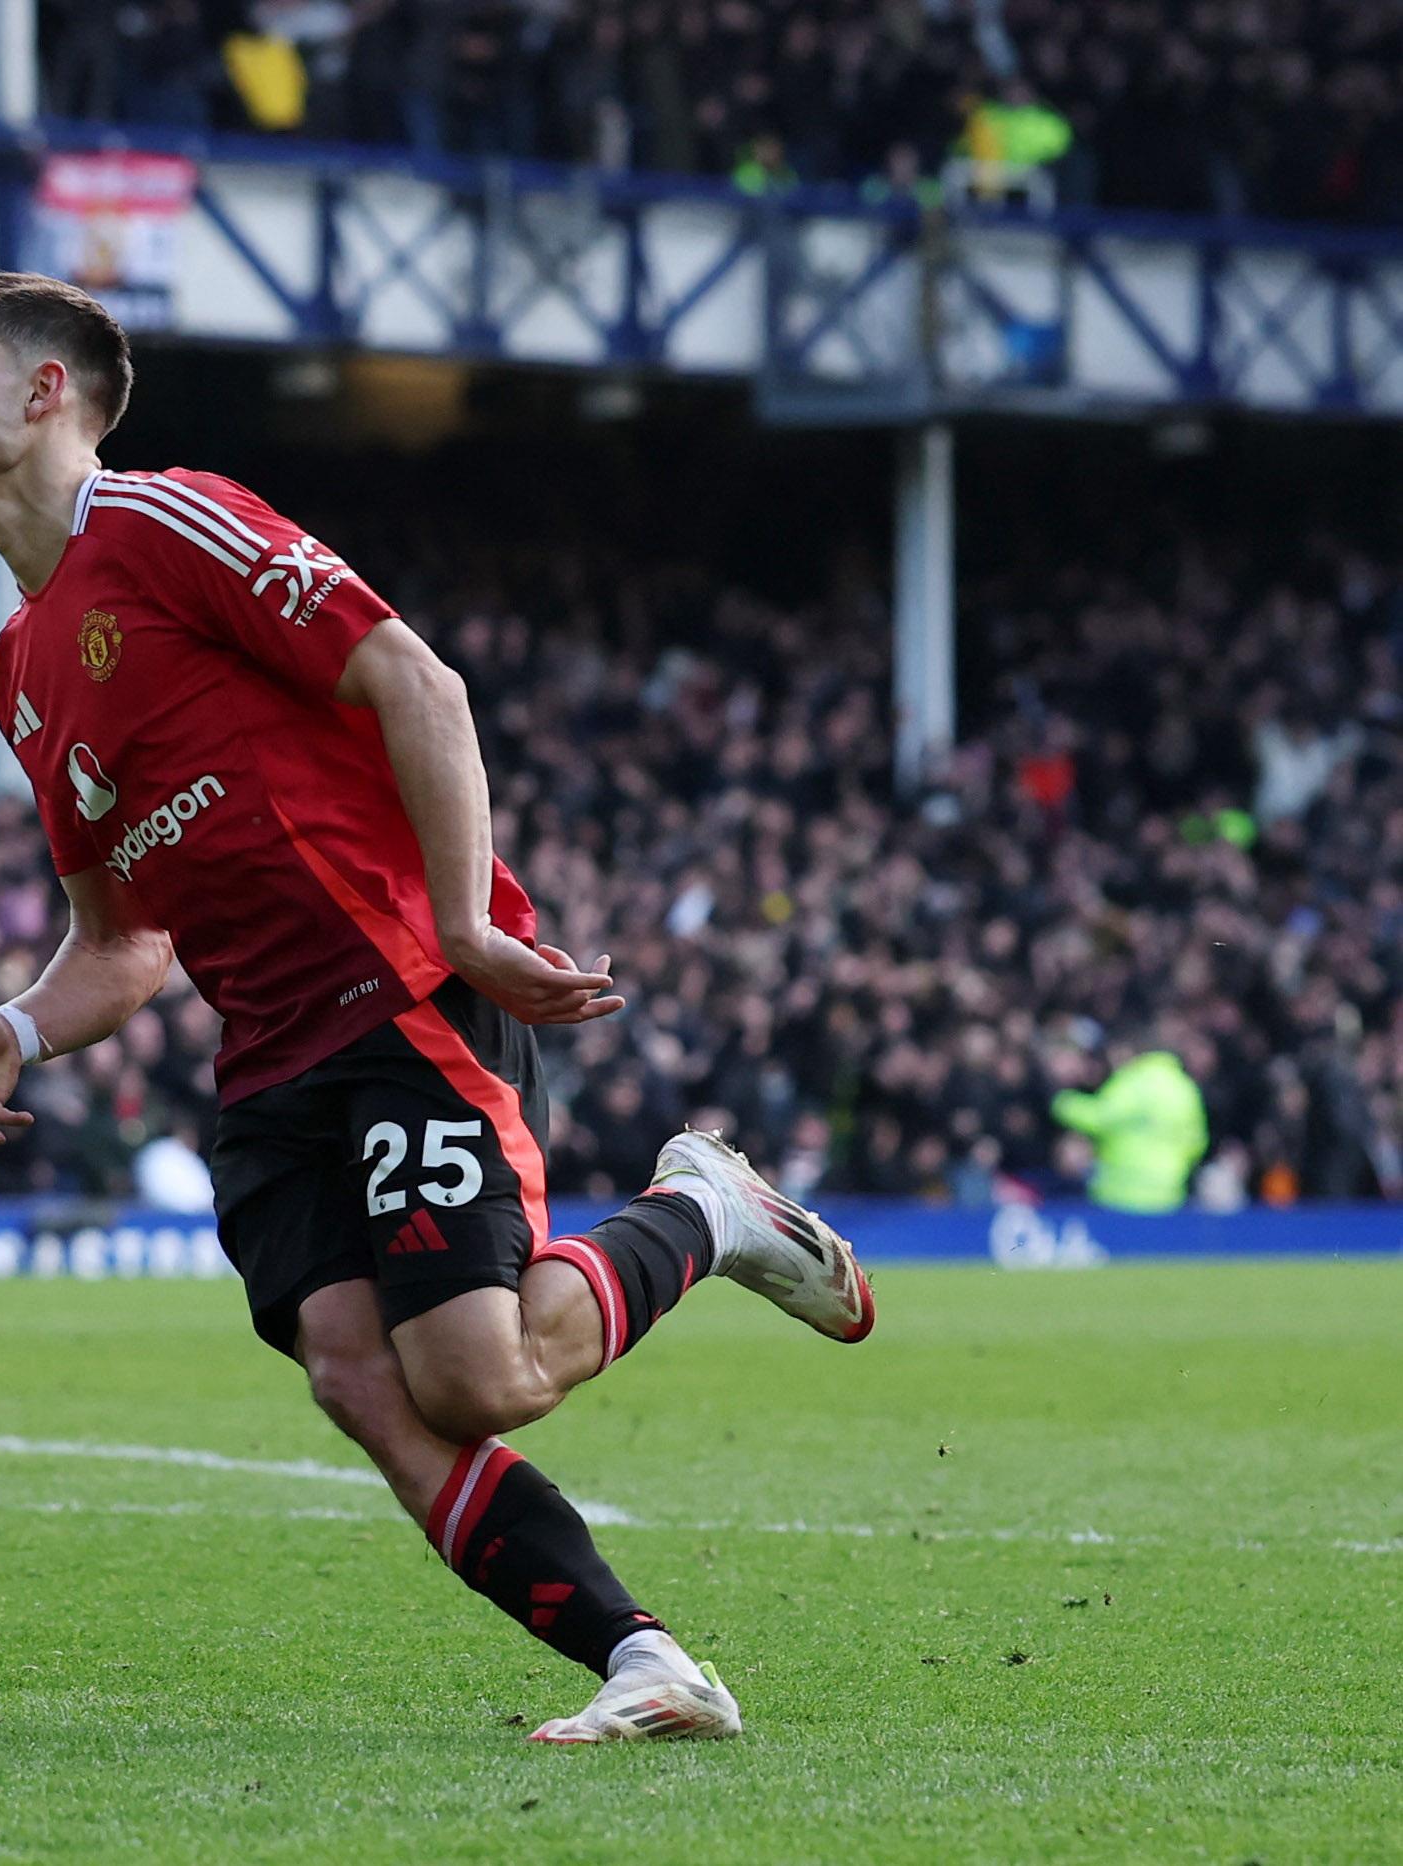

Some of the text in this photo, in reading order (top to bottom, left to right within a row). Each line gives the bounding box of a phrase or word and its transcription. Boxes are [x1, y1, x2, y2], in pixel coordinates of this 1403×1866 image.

[338, 977, 380, 1007] HEAT RDY
[362, 1119, 484, 1217] 25
